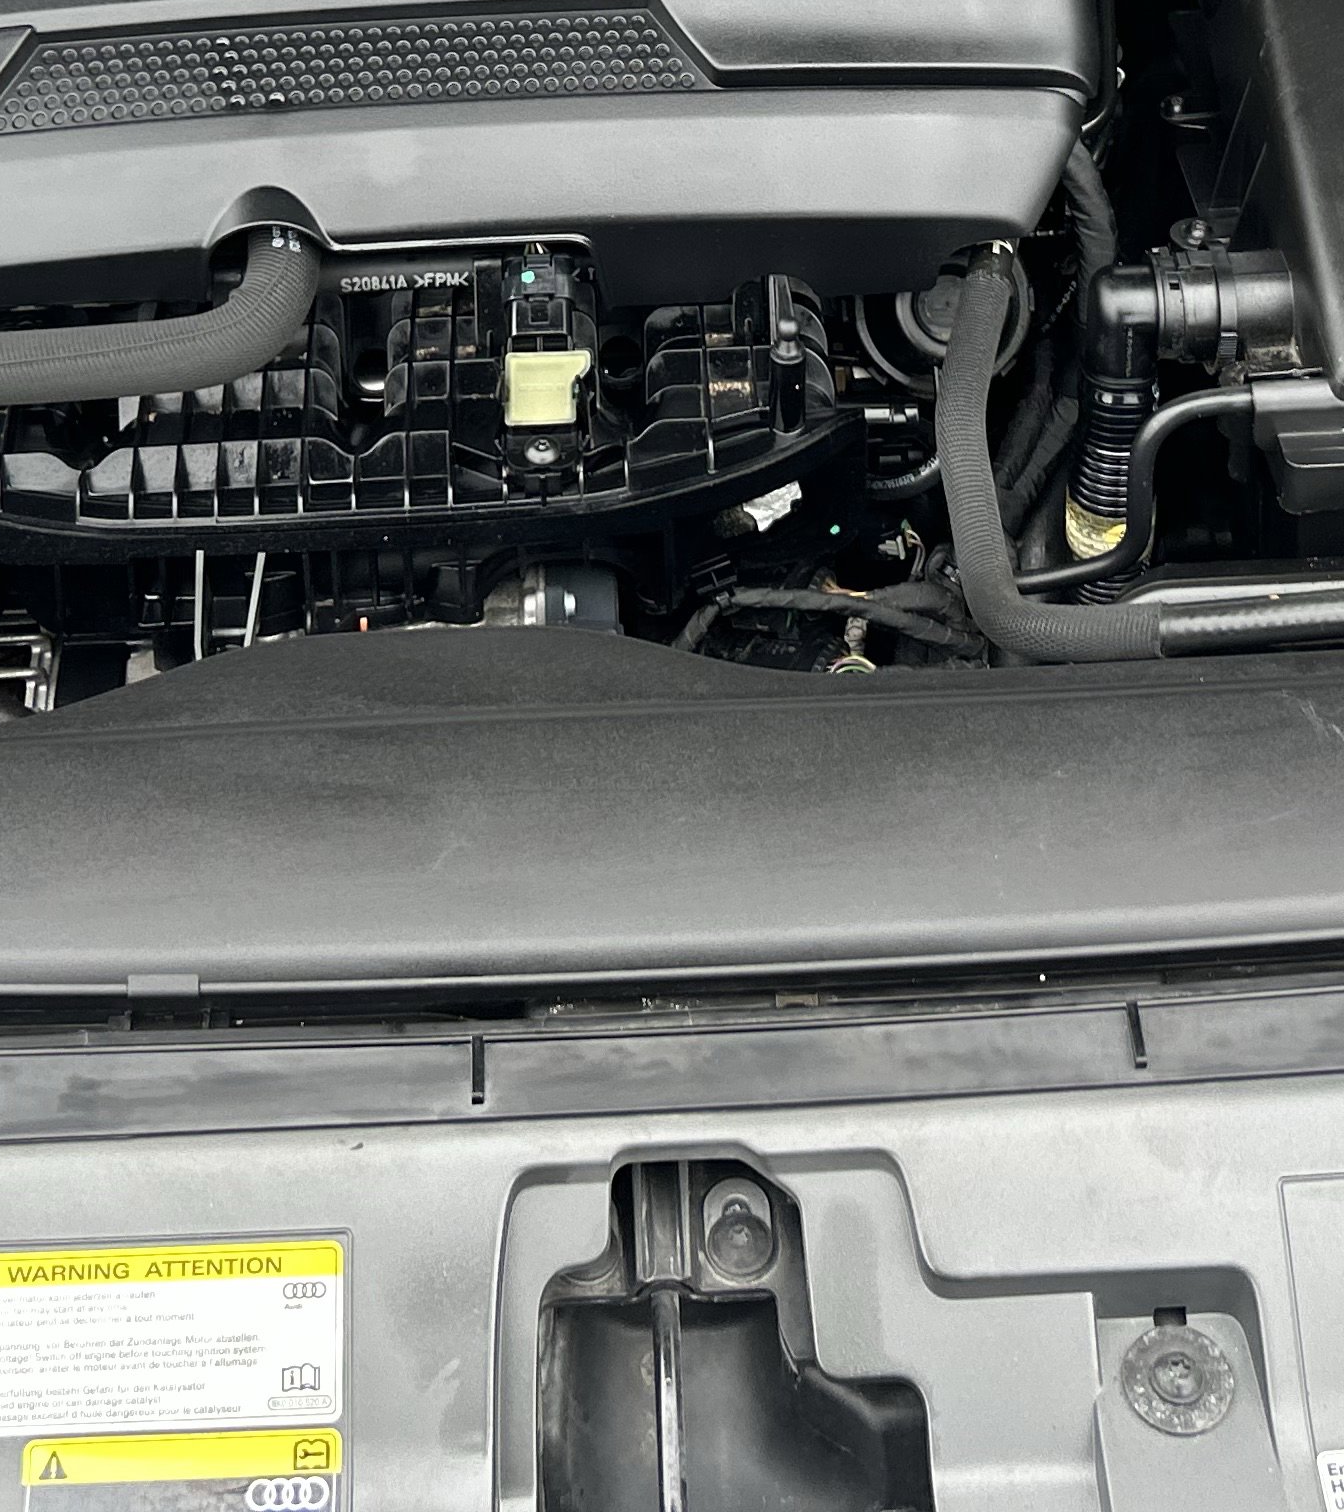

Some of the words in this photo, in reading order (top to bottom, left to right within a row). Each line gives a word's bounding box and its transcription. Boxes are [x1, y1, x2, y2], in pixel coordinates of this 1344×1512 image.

[340, 274, 408, 293] S20841A
[413, 271, 469, 288] >FPM<
[7, 1261, 130, 1283] WARNING
[145, 1255, 283, 1279] ATTENTION
[151, 1346, 194, 1358] touching
